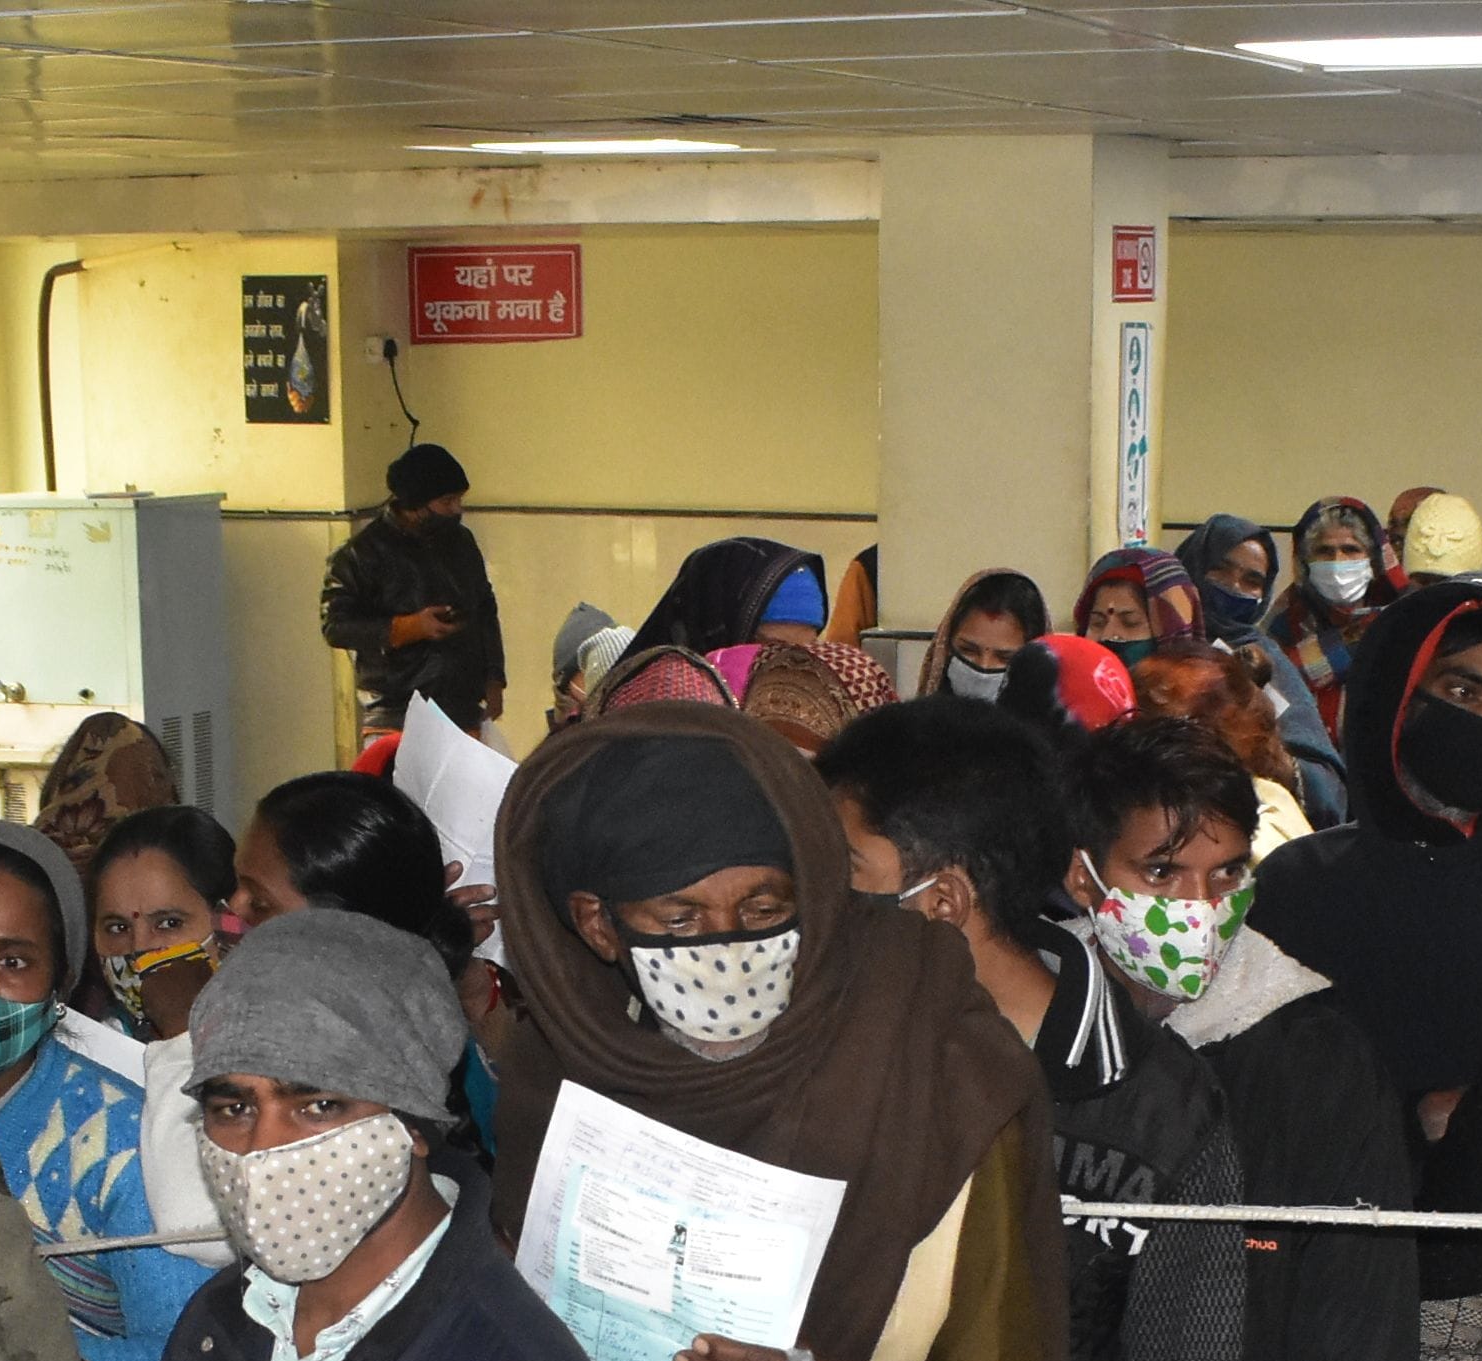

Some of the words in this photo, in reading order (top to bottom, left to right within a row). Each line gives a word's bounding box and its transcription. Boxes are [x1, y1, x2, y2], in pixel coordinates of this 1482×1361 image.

[454, 258, 497, 288] यहां
[503, 264, 535, 287] पर
[424, 300, 492, 333] थूकना
[495, 299, 542, 321] मना
[547, 289, 566, 323] है
[1052, 1135, 1155, 1204] MA
